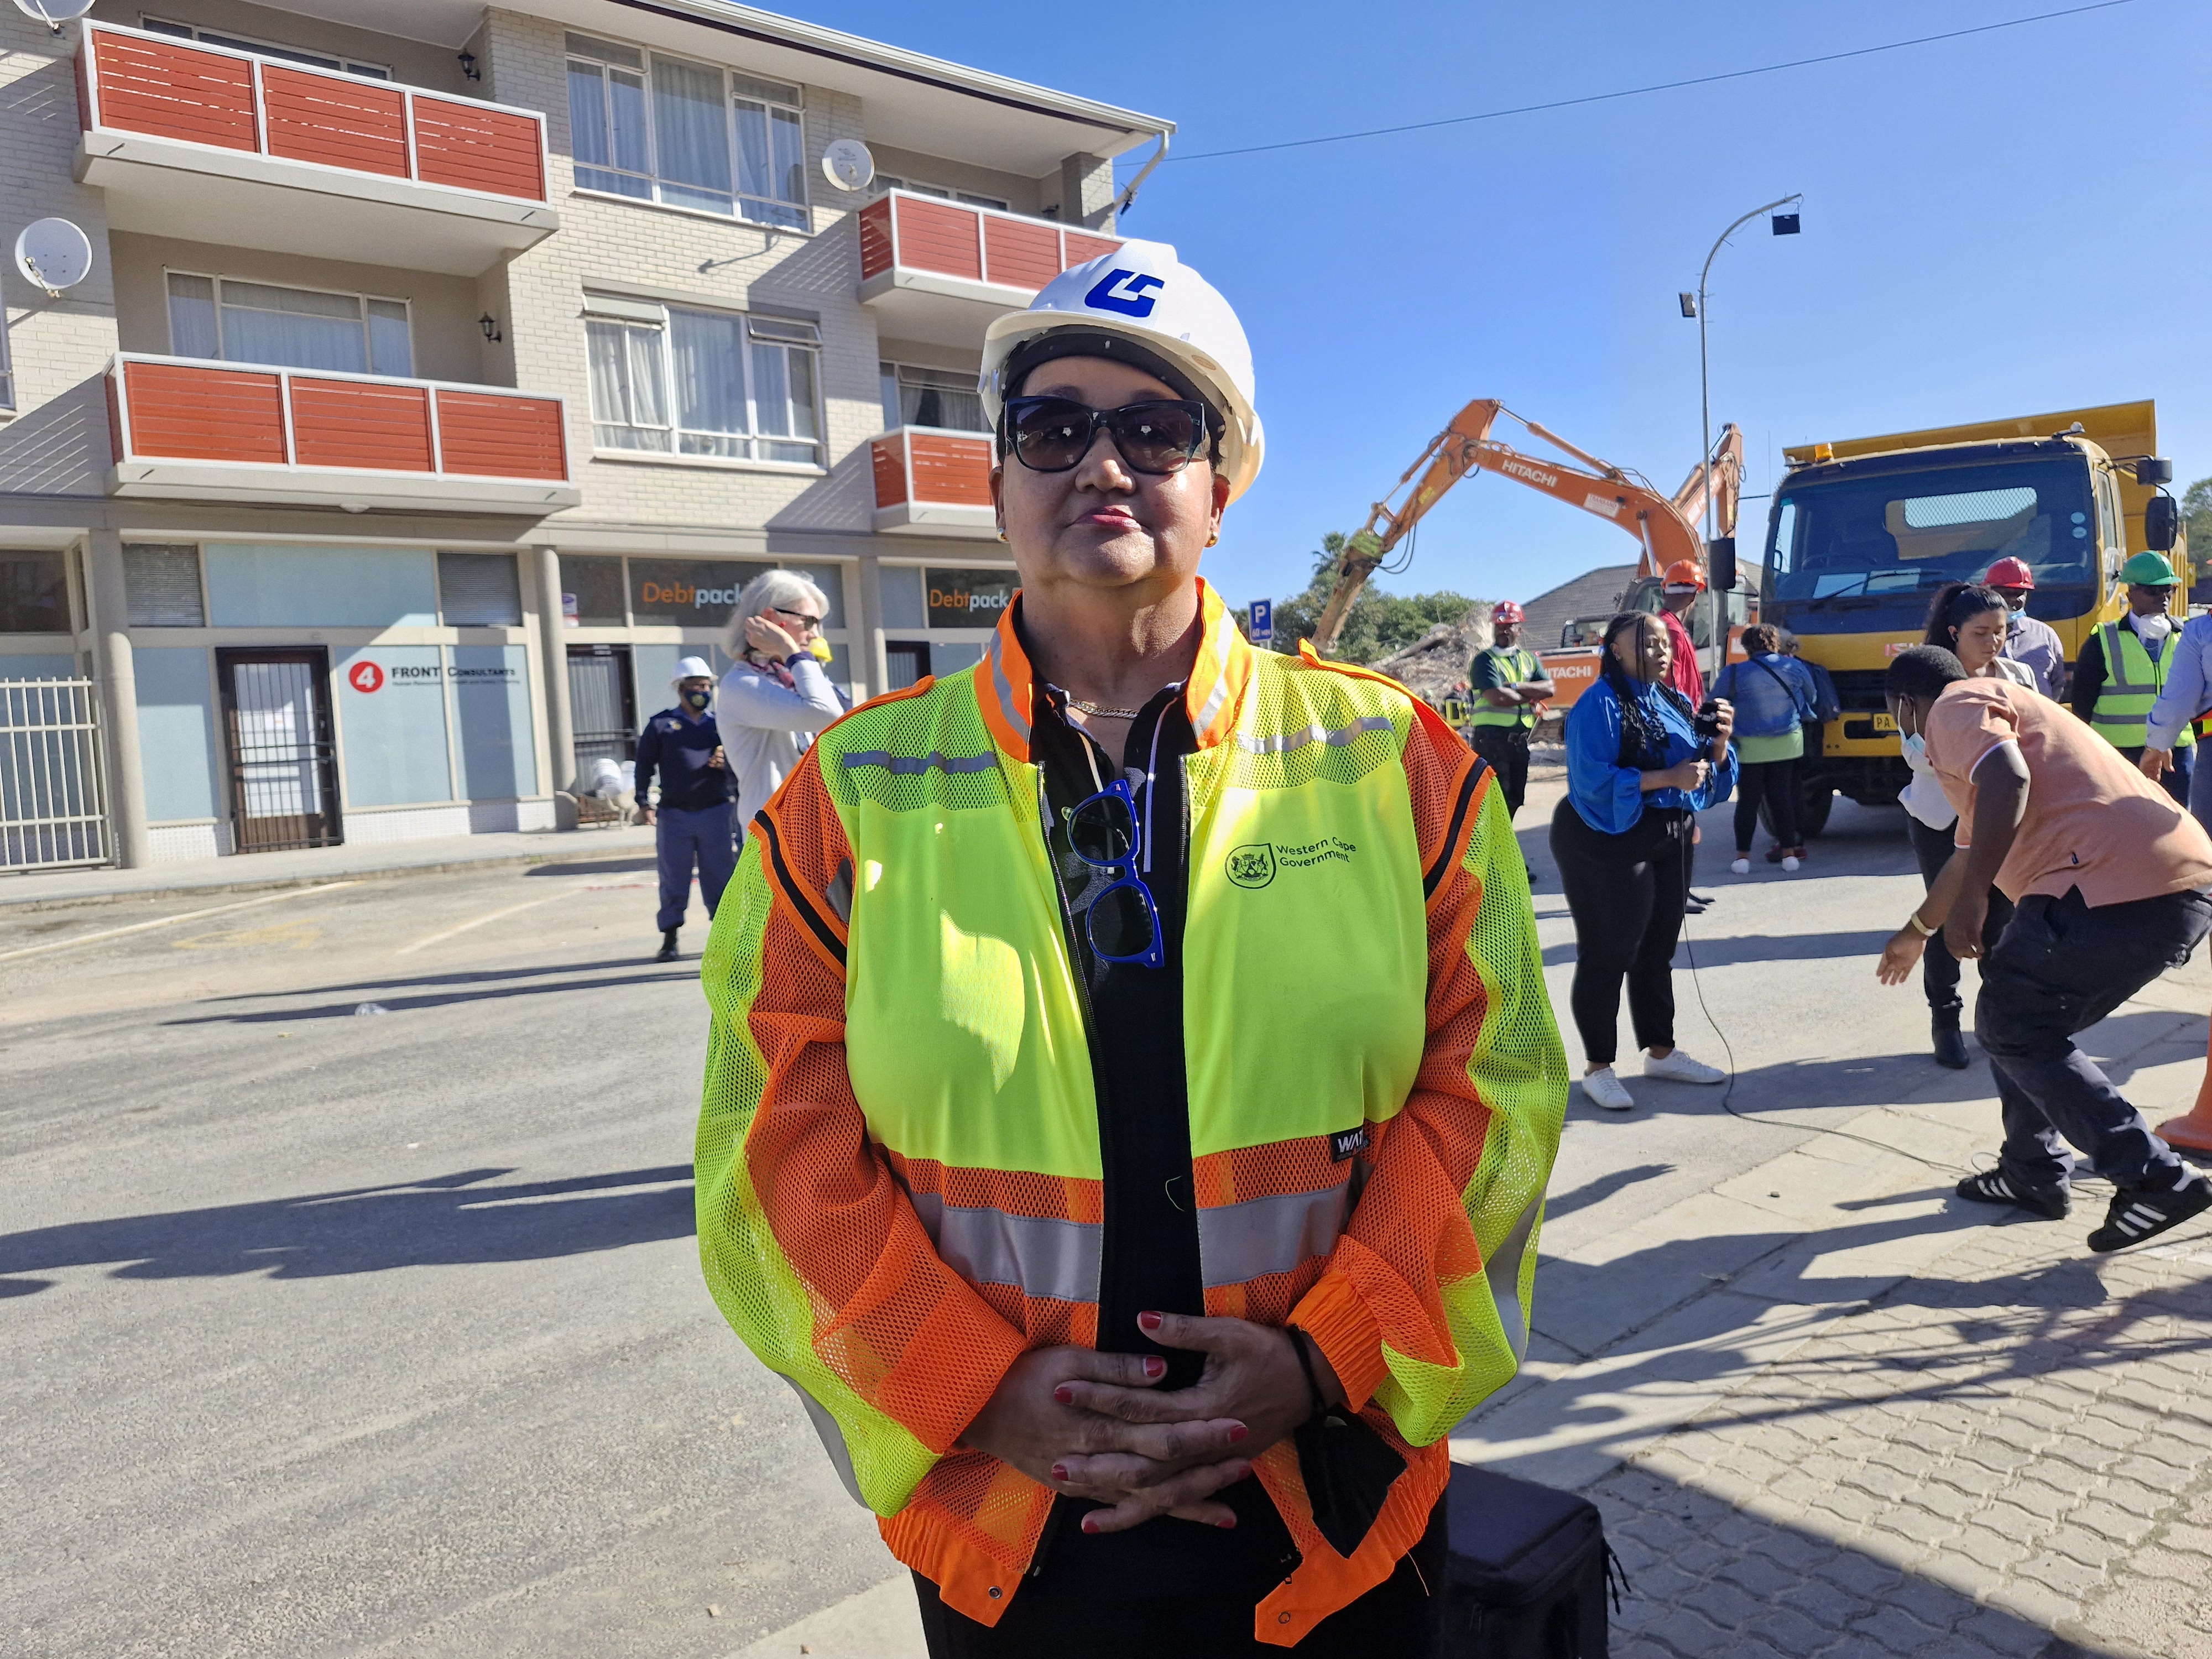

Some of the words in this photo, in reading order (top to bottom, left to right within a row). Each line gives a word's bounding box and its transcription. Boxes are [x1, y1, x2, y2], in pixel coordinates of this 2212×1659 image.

[1501, 459, 1559, 488] HITACHI
[930, 588, 1009, 613] Debtpack
[1254, 604, 1267, 624] P
[356, 665, 376, 688] 4
[392, 666, 441, 678] FRONT
[1276, 839, 1329, 855] Western
[1332, 836, 1357, 852] Cape
[1280, 849, 1350, 867] Government
